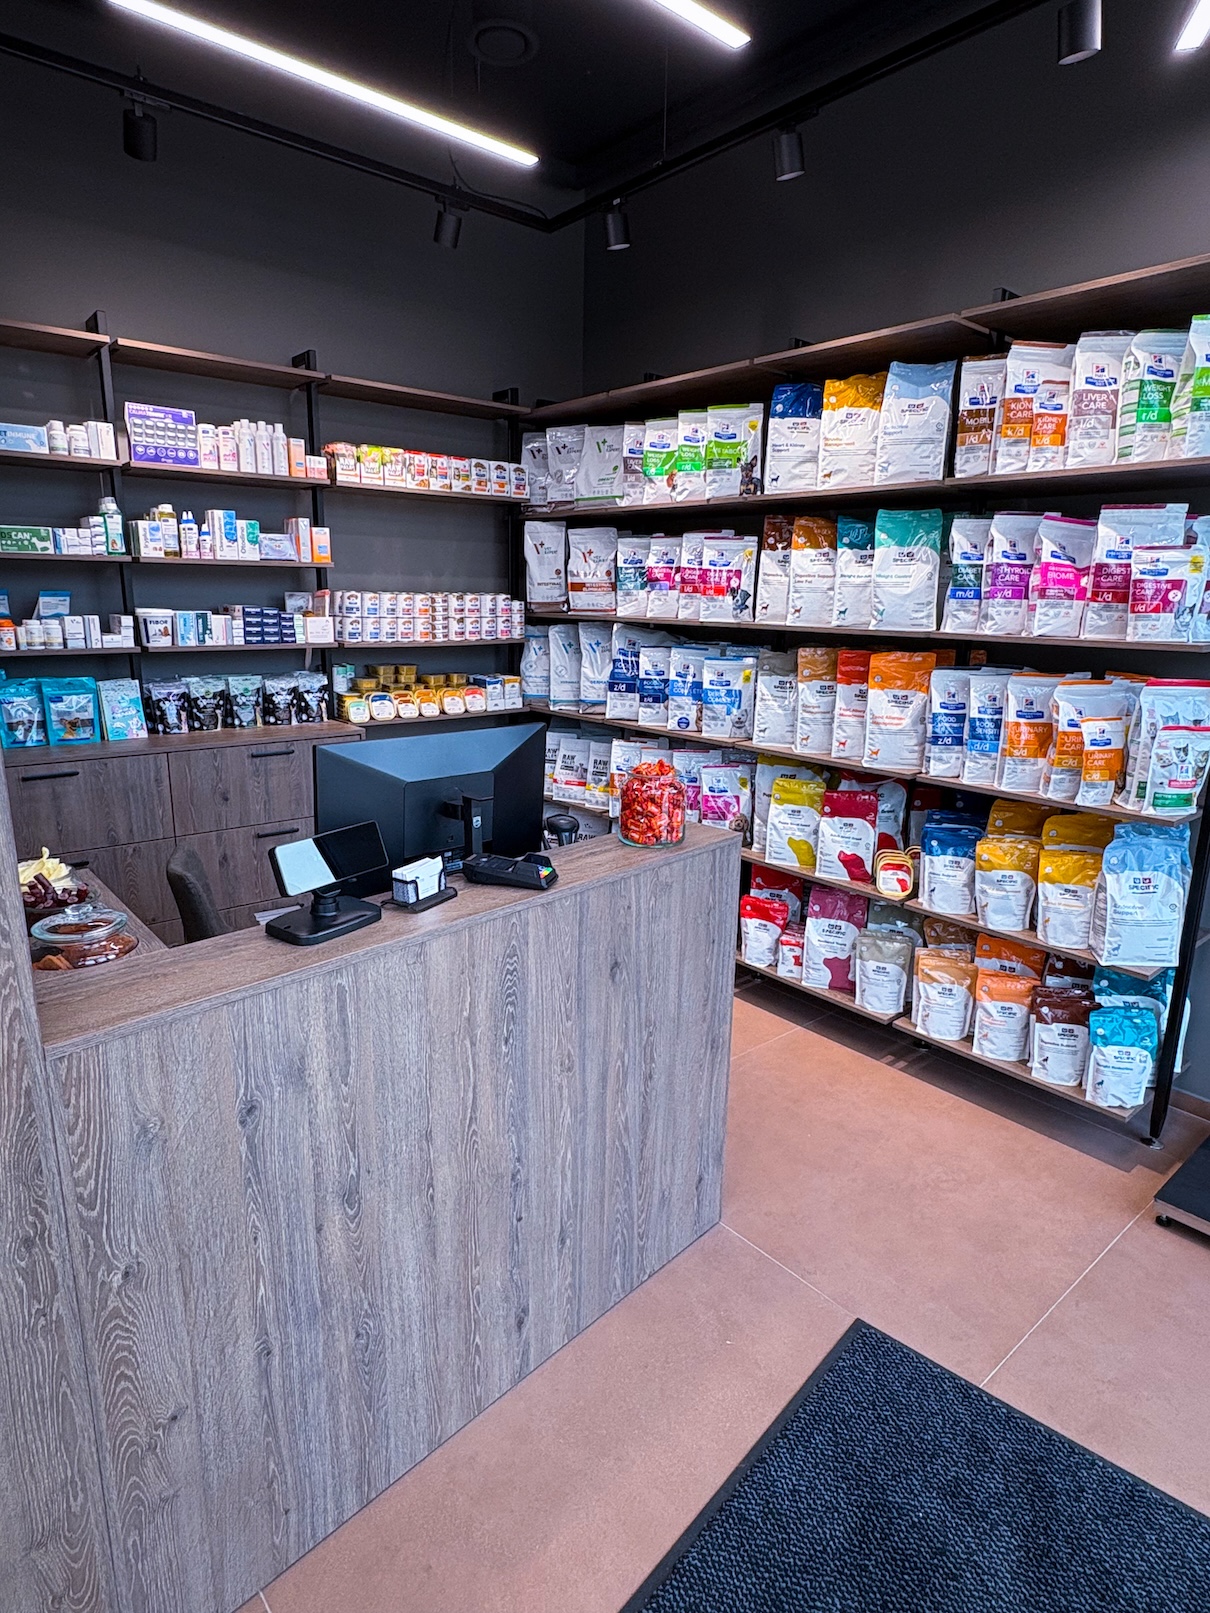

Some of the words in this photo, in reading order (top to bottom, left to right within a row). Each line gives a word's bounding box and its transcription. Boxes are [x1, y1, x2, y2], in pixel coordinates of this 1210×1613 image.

[1143, 384, 1171, 392] WEIGHT
[1083, 393, 1108, 401] LIVER
[1143, 391, 1163, 400] LOSS
[1082, 402, 1107, 410] CARE
[1142, 411, 1158, 420] r/d
[1037, 416, 1063, 424] KIDNEY
[1007, 427, 1025, 436] k/d
[1035, 437, 1050, 445] k/d
[999, 566, 1032, 575] THYROID
[998, 574, 1020, 582] CARE
[1047, 571, 1075, 580] BIOME
[1100, 575, 1124, 583] CARE
[1136, 582, 1173, 590] DIGESTIVE
[955, 589, 974, 598] m/d
[996, 588, 1012, 599] y/d
[613, 684, 626, 692] z/d
[937, 737, 952, 745] z/d
[1014, 733, 1035, 741] CARE
[973, 743, 990, 751] d/d
[1012, 748, 1028, 757] s/d
[1061, 758, 1078, 767] c/d
[1087, 759, 1106, 767] CARE
[1085, 771, 1101, 780] c/d
